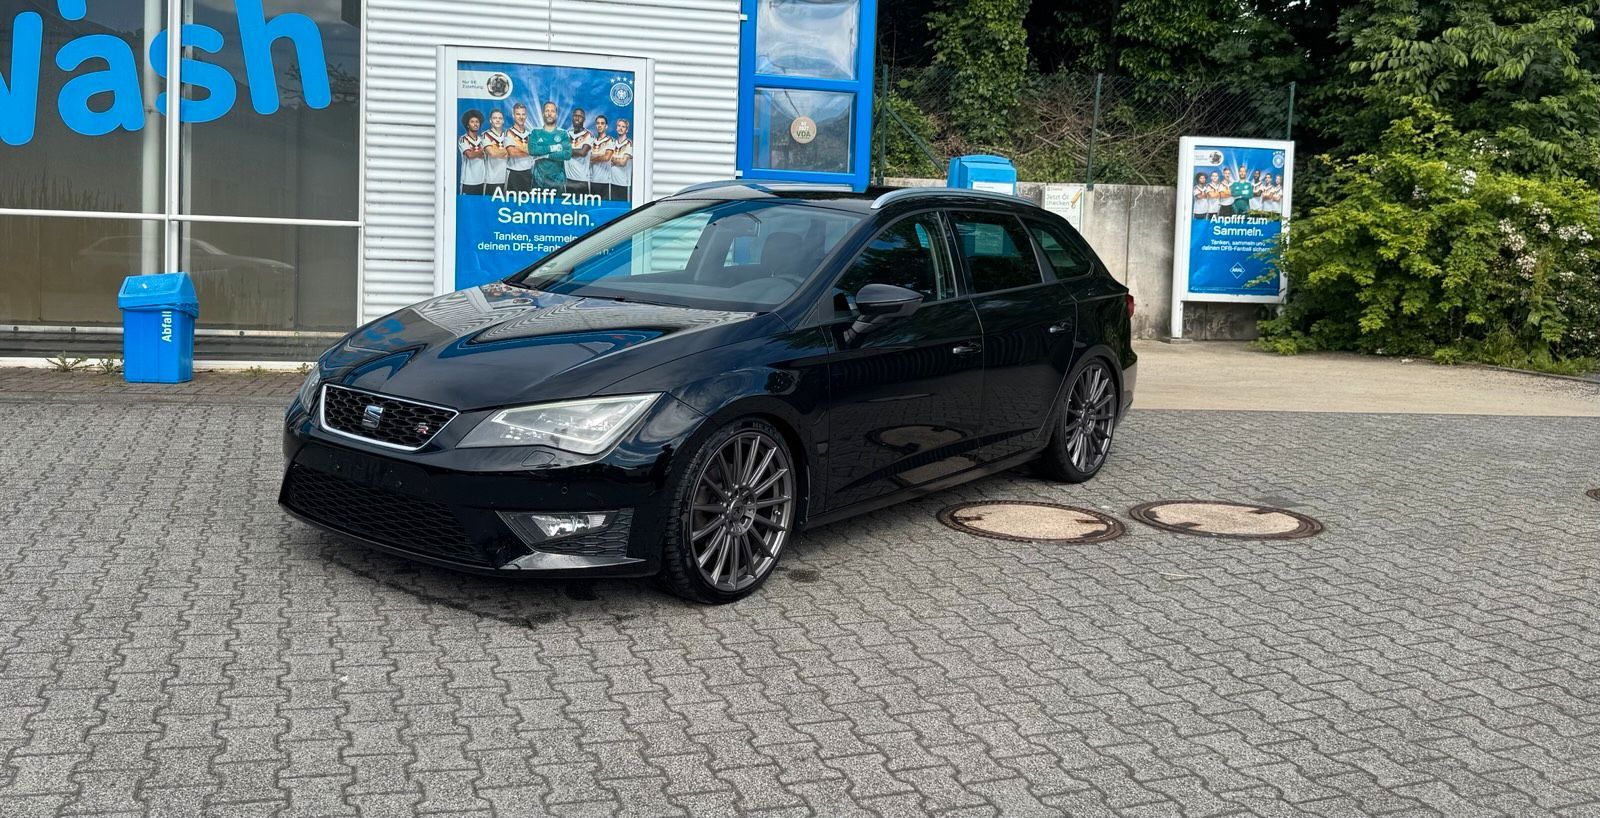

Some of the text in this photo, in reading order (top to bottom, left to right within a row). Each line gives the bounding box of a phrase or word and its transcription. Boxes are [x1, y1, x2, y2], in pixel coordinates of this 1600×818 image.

[491, 186, 602, 207] Anpfiff zum
[498, 208, 595, 227] Sammeln.
[1210, 214, 1268, 225] Anpfiff zum
[494, 231, 532, 243] Tanken,
[1213, 226, 1264, 237] Sammeln.
[478, 241, 561, 253] deinen DFB-Fanb
[162, 311, 172, 342] Abfall
